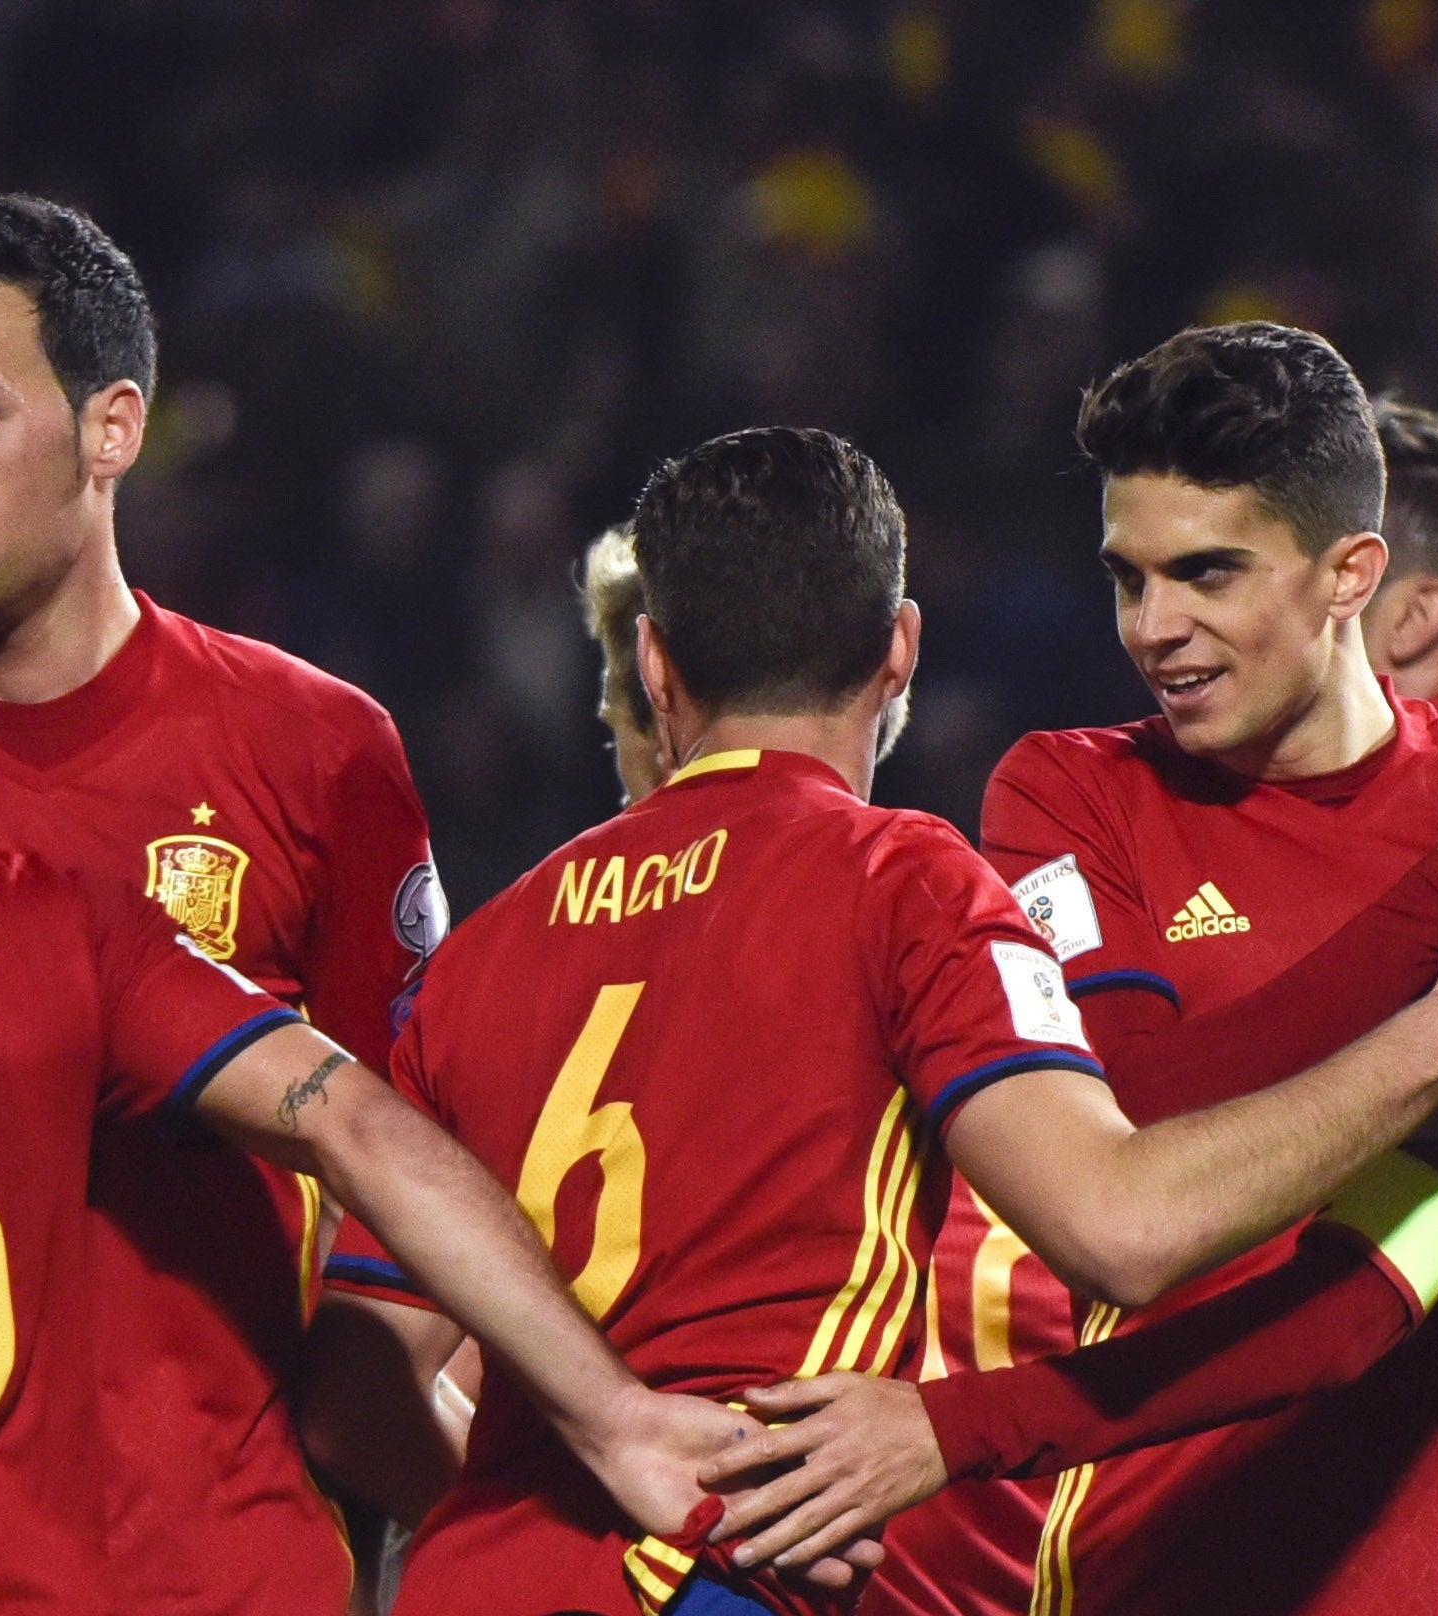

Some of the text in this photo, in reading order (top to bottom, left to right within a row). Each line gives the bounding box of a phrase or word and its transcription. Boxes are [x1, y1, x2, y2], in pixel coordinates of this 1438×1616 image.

[549, 828, 727, 925] NACHO
[1166, 914, 1251, 943] adidas
[515, 982, 647, 1322] 6
